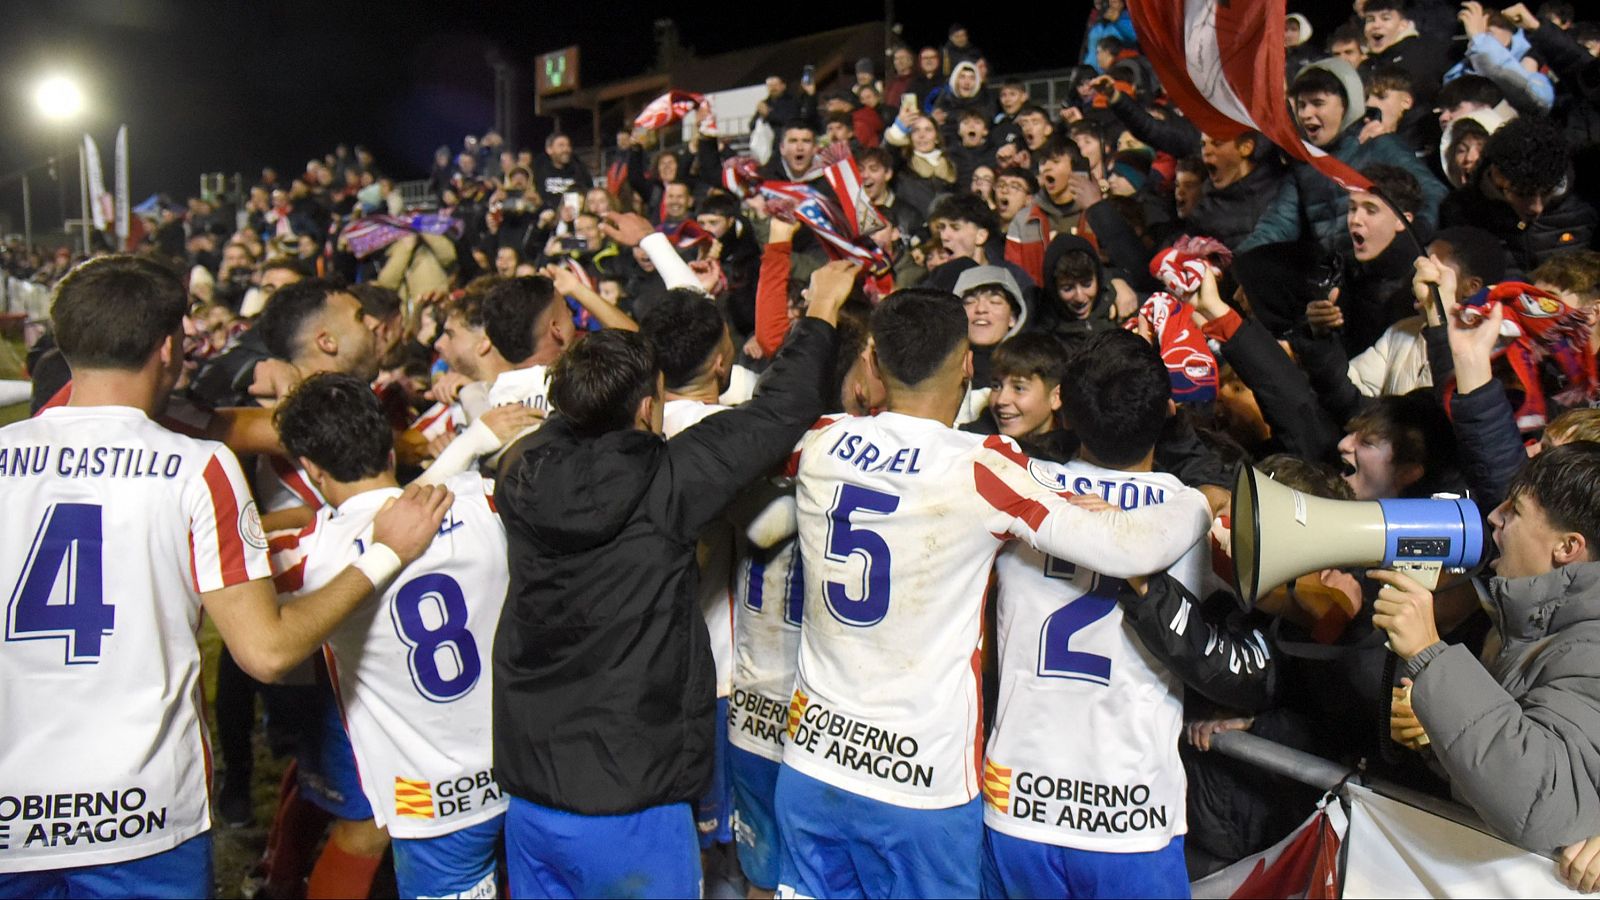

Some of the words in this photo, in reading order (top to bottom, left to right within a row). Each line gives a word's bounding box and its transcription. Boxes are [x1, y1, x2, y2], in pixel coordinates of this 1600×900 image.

[56, 447, 183, 480] CASTILLO
[821, 483, 901, 628] 5
[5, 502, 116, 666] 4
[390, 573, 482, 703] 8
[804, 704, 918, 758] GOBIERNO
[794, 724, 821, 754] DE
[824, 741, 934, 788] ARAGON
[438, 795, 471, 817] DE
[1016, 772, 1150, 808] GOBIERNO
[23, 807, 167, 848] ARAGON
[1013, 796, 1047, 823] DE
[1056, 805, 1167, 833] ARAGON
